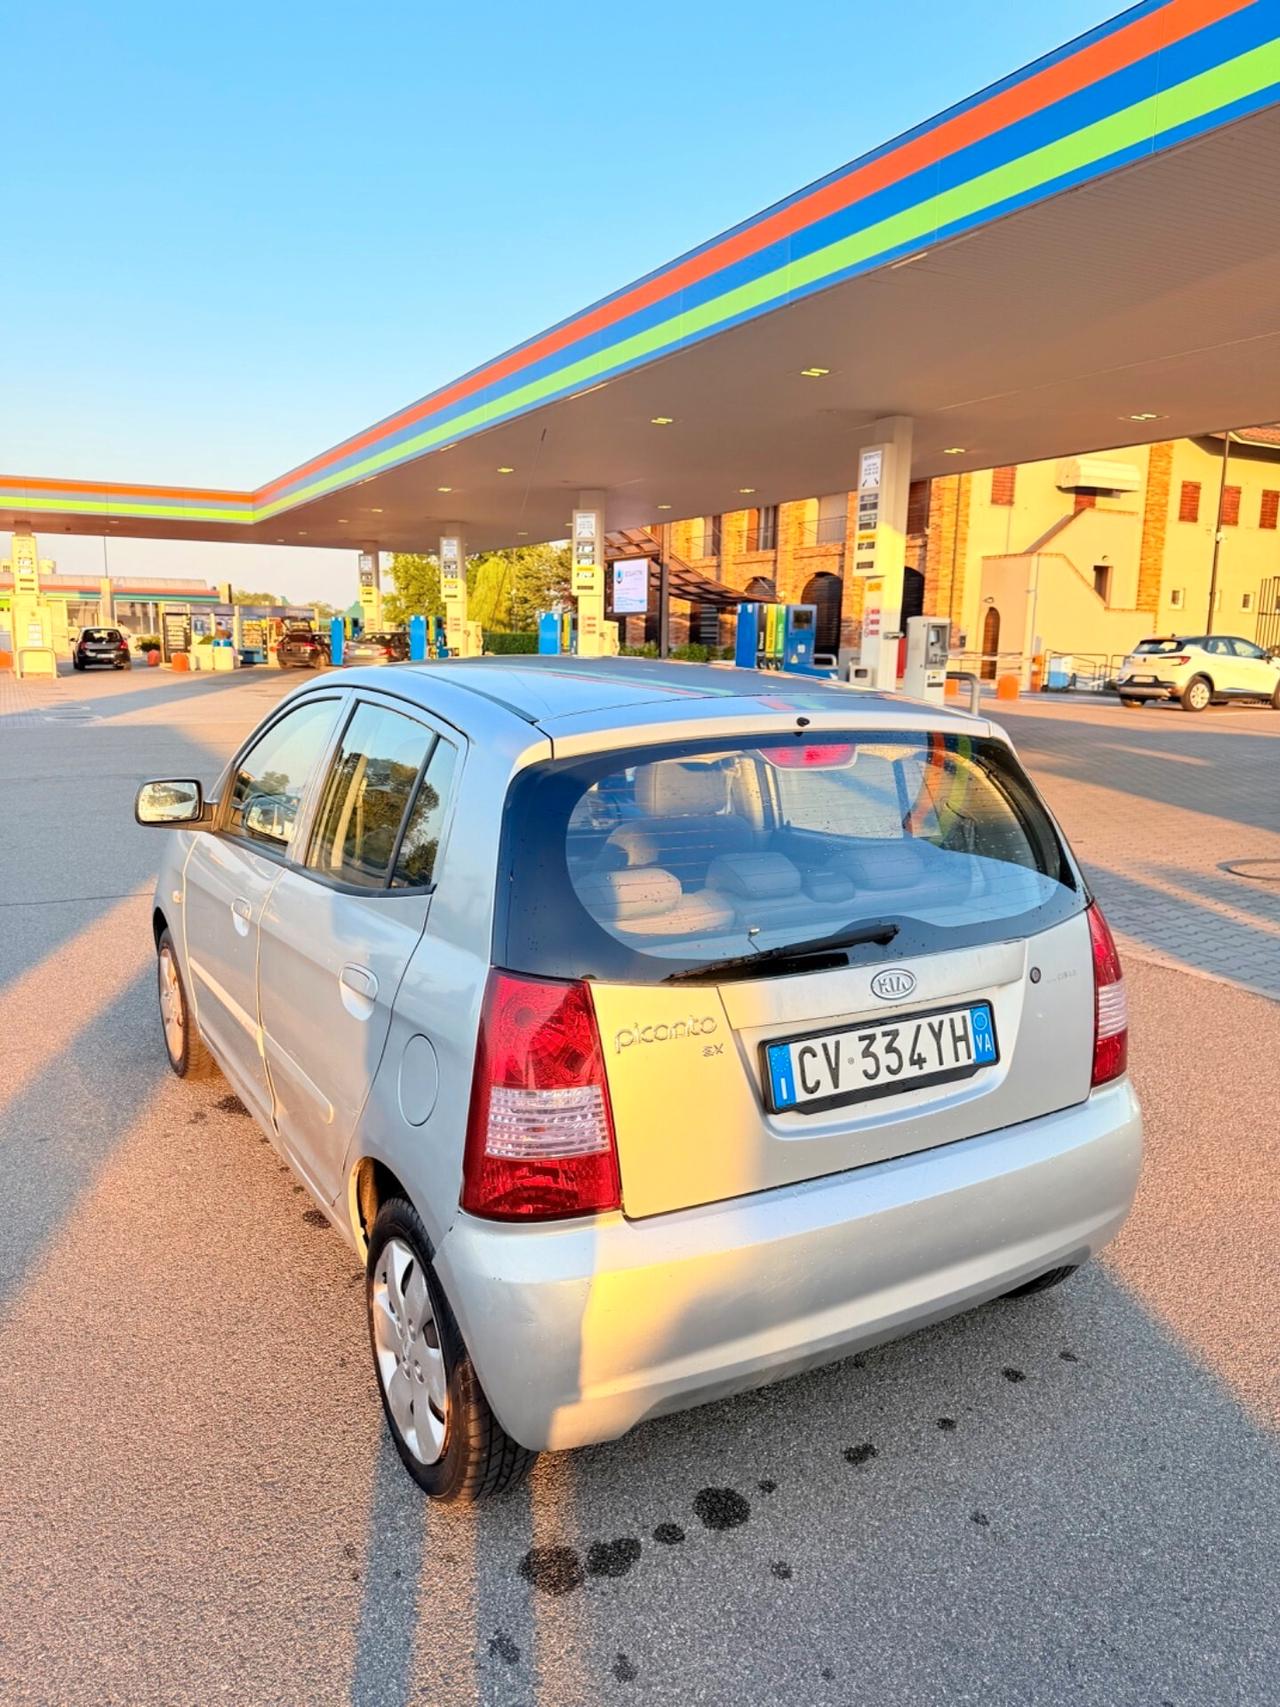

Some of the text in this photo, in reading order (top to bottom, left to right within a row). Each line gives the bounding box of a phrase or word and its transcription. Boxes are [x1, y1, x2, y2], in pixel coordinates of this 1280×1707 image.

[877, 975, 908, 994] KIA
[615, 1014, 718, 1055] picanto
[975, 1034, 993, 1053] VA
[798, 1014, 973, 1095] CV 334YH
